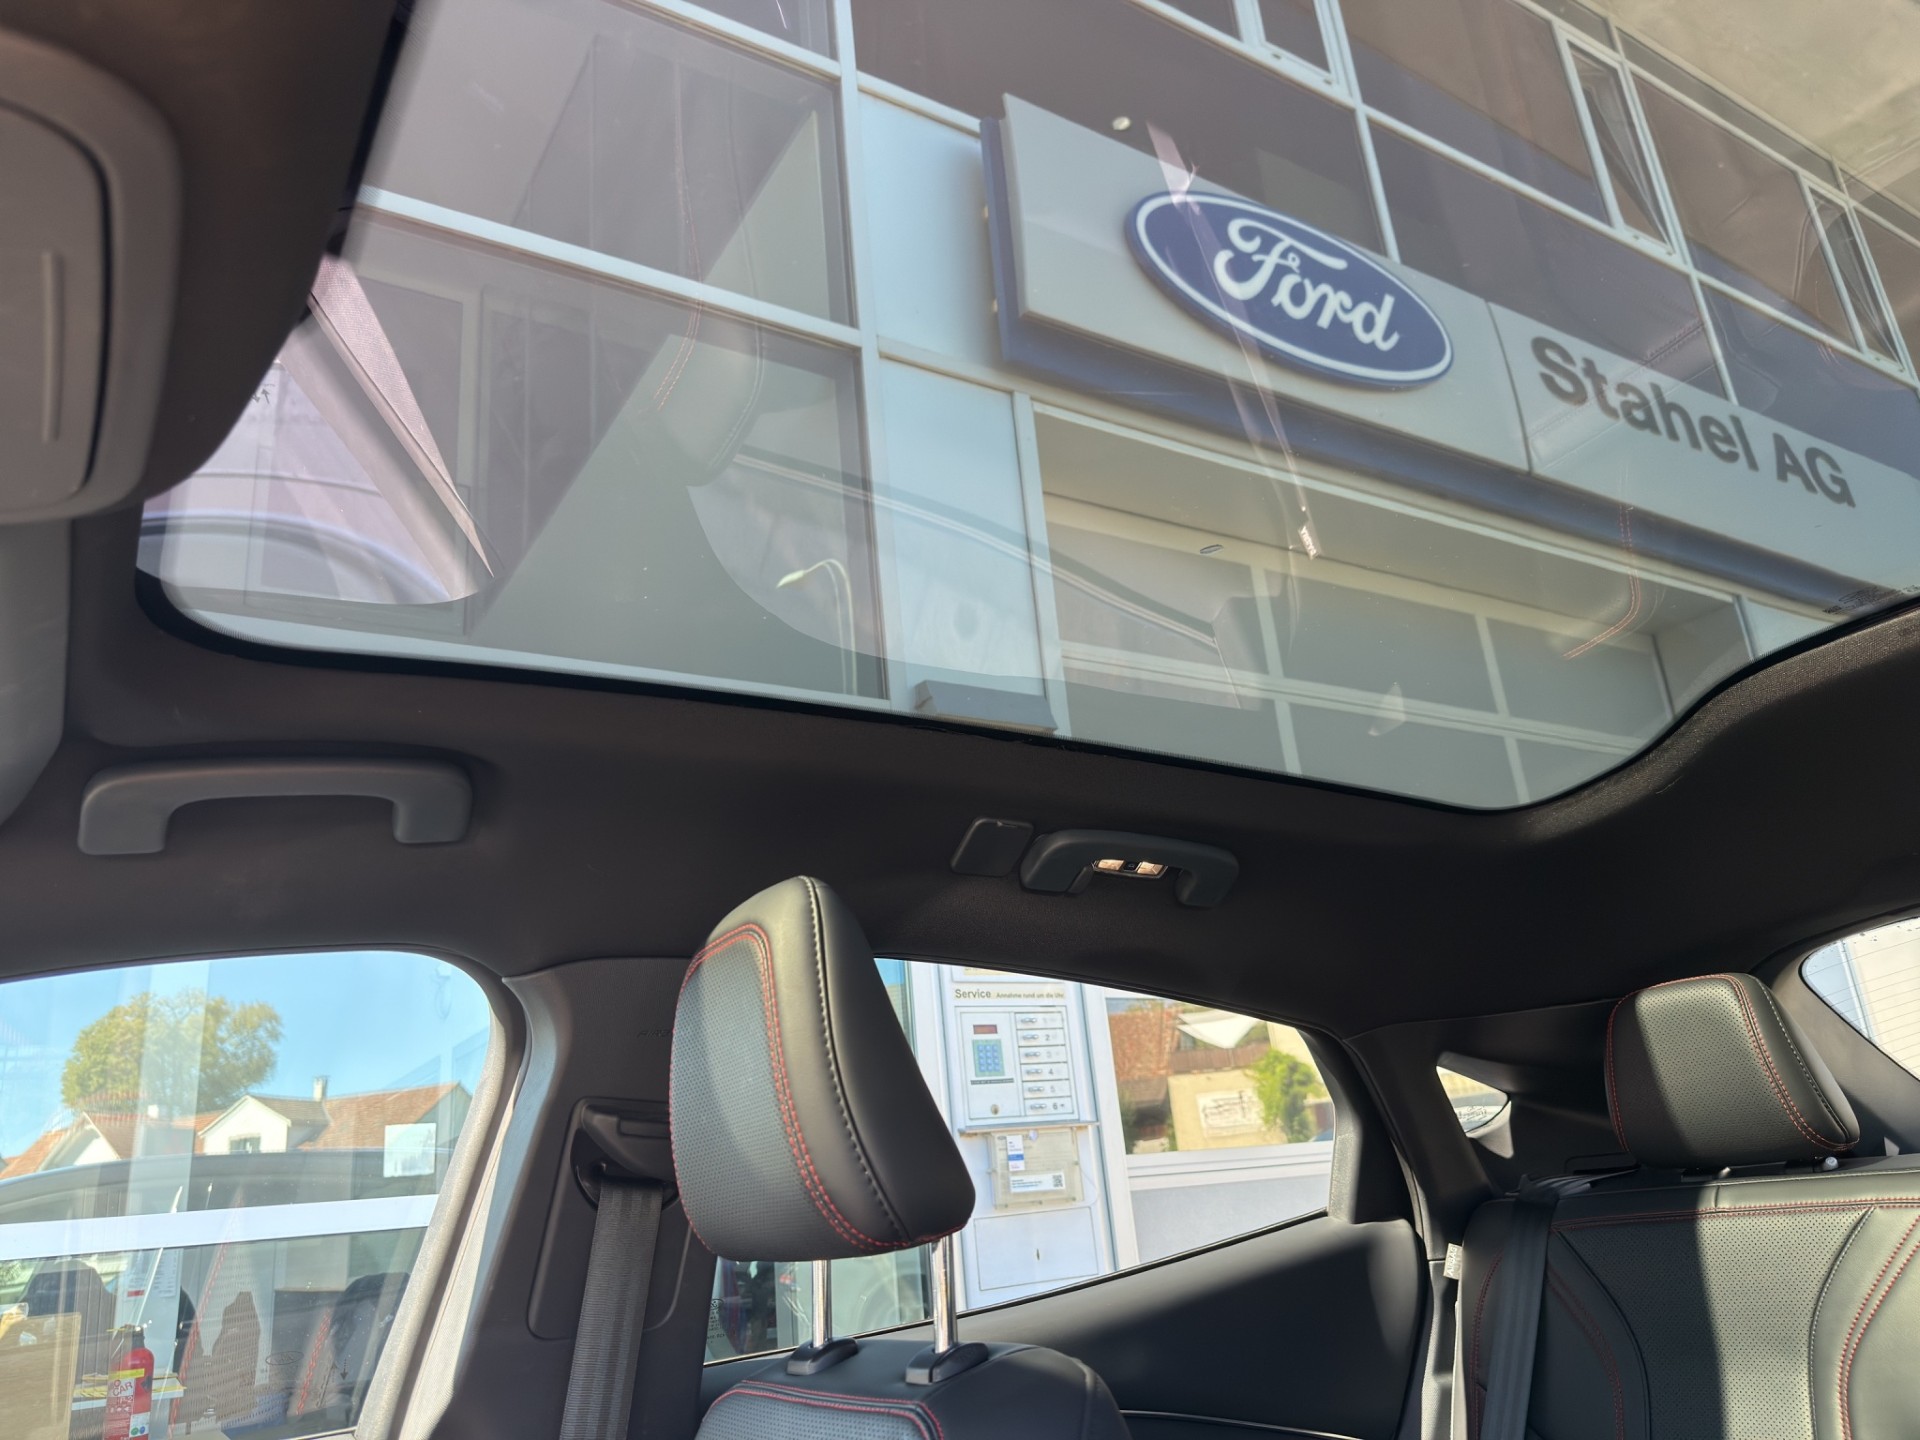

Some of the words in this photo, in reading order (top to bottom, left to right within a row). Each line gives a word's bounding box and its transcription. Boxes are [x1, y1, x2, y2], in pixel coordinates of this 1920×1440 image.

[1214, 218, 1400, 351] Ford
[1530, 336, 1760, 472] Stahel
[1772, 432, 1856, 508] AG
[954, 988, 992, 999] Service
